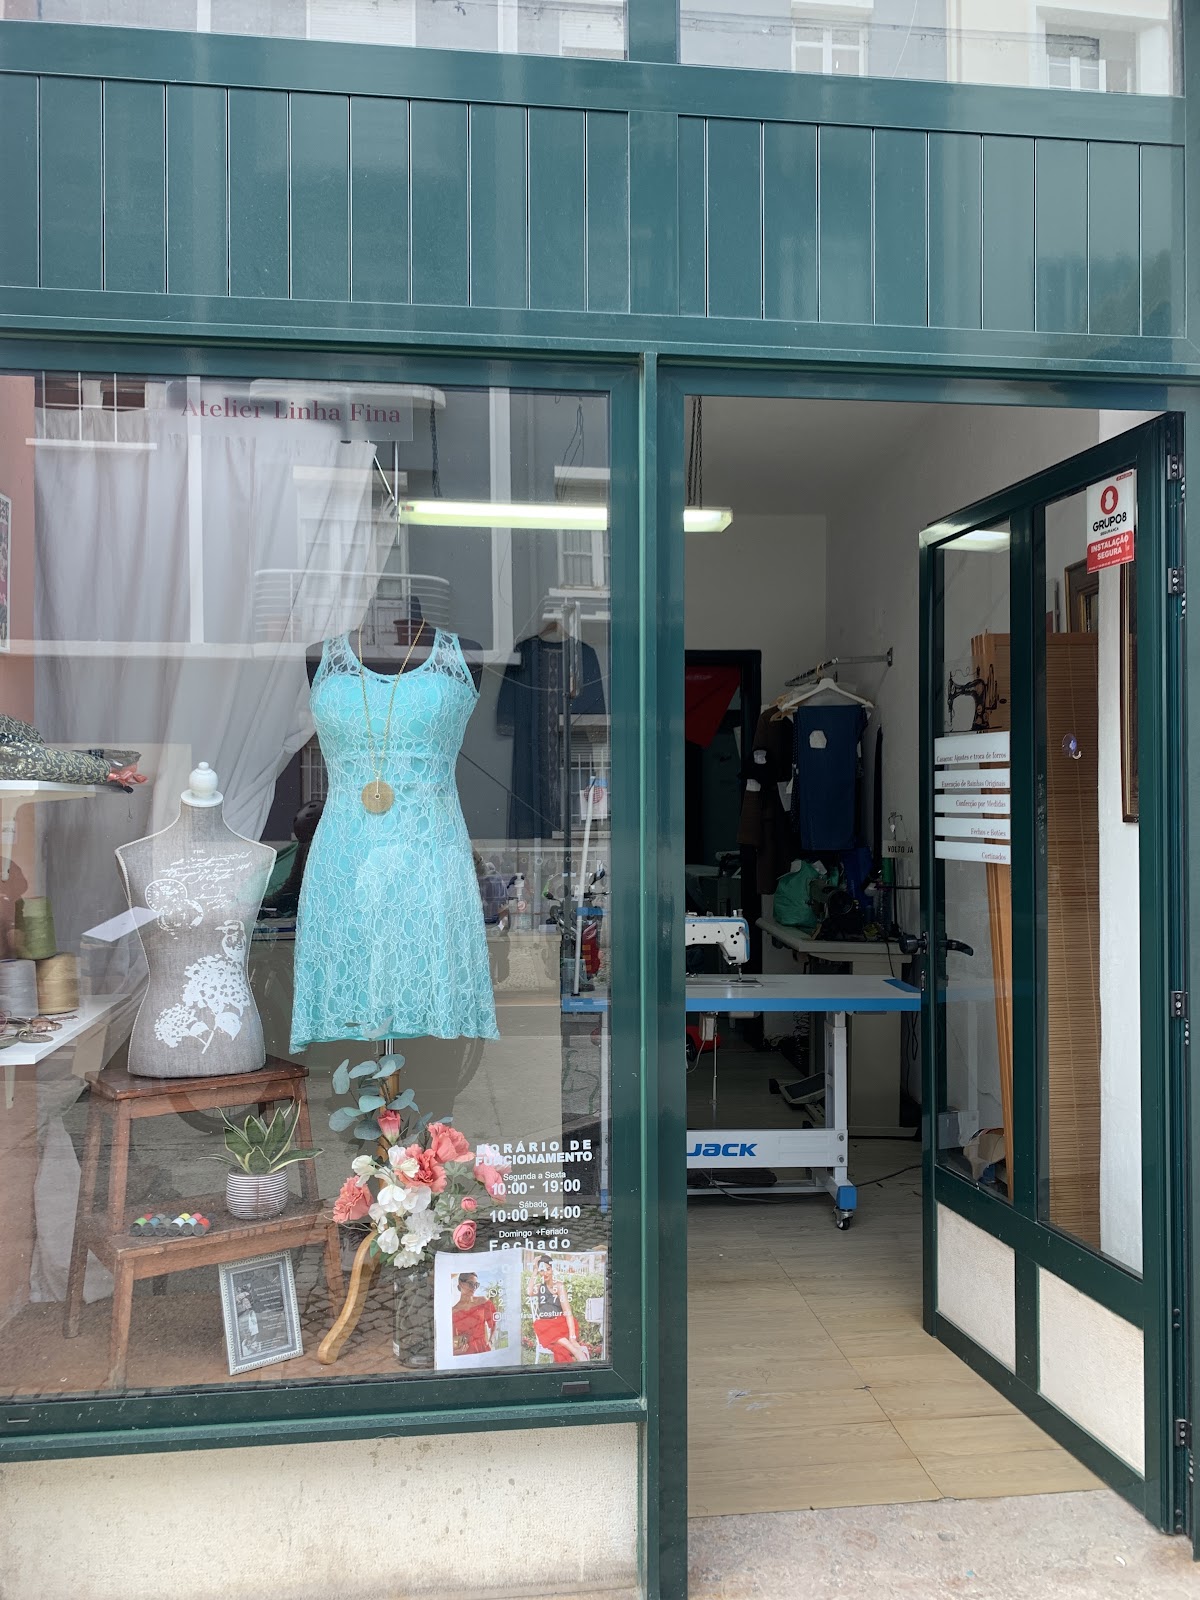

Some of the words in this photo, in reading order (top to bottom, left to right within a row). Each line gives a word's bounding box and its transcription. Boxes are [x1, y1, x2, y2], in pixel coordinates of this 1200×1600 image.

[181, 397, 263, 418] Atelier
[273, 400, 342, 421] Linha
[349, 403, 401, 423] Fina
[1092, 511, 1127, 532] GRUPO8
[1090, 534, 1129, 553] INSTALAÇÃO
[1097, 546, 1122, 560] SEGURA
[570, 1139, 592, 1151] DE
[503, 1173, 536, 1182] Segunda
[545, 1171, 566, 1179] Sexta
[491, 1182, 528, 1196] 10:00
[542, 1179, 580, 1193] 19:00
[519, 1200, 548, 1209] Sábado
[490, 1209, 529, 1223] 10:00
[542, 1205, 581, 1220] 14:00
[499, 1229, 532, 1239] Domingo
[489, 1237, 571, 1252] Fechado
